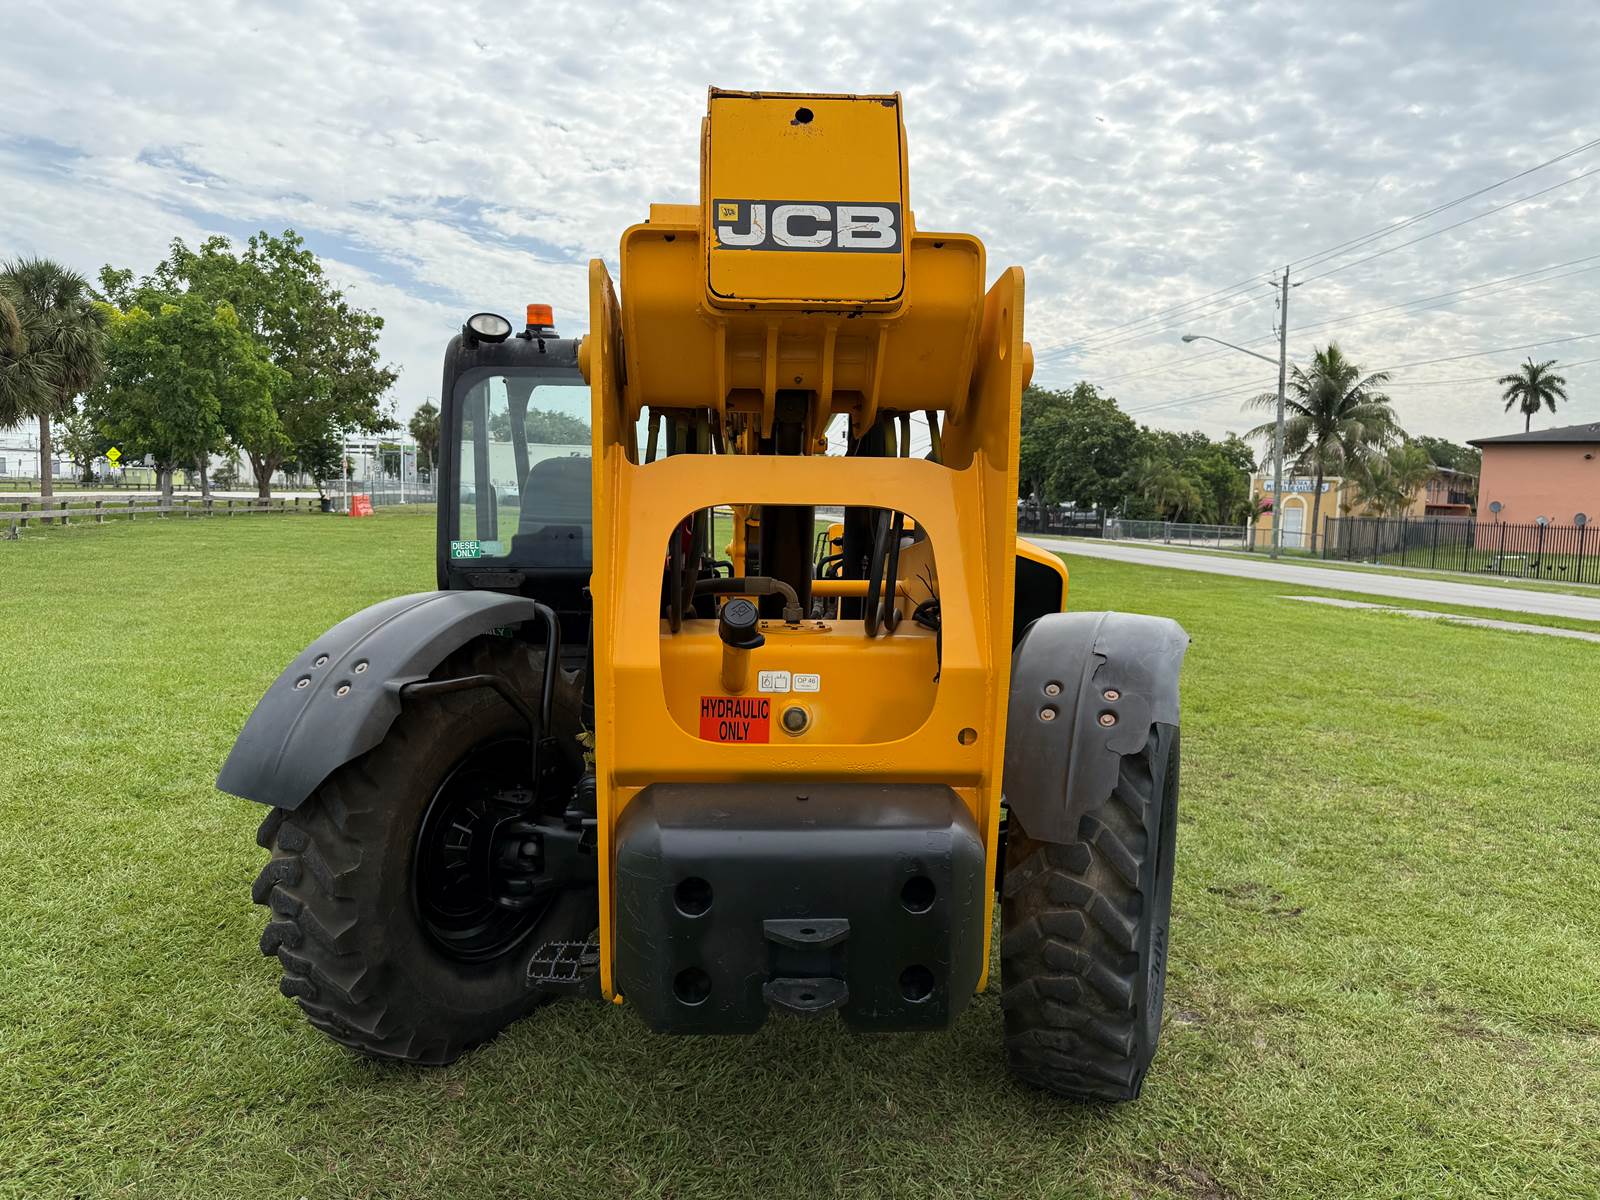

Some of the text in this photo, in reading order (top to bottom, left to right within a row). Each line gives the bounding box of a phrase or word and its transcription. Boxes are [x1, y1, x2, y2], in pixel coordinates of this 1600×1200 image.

[718, 203, 897, 249] JCB
[452, 541, 479, 550] DIESEL
[456, 549, 476, 558] ONLY
[701, 698, 769, 719] HYDRAULIC
[719, 720, 750, 741] ONLY
